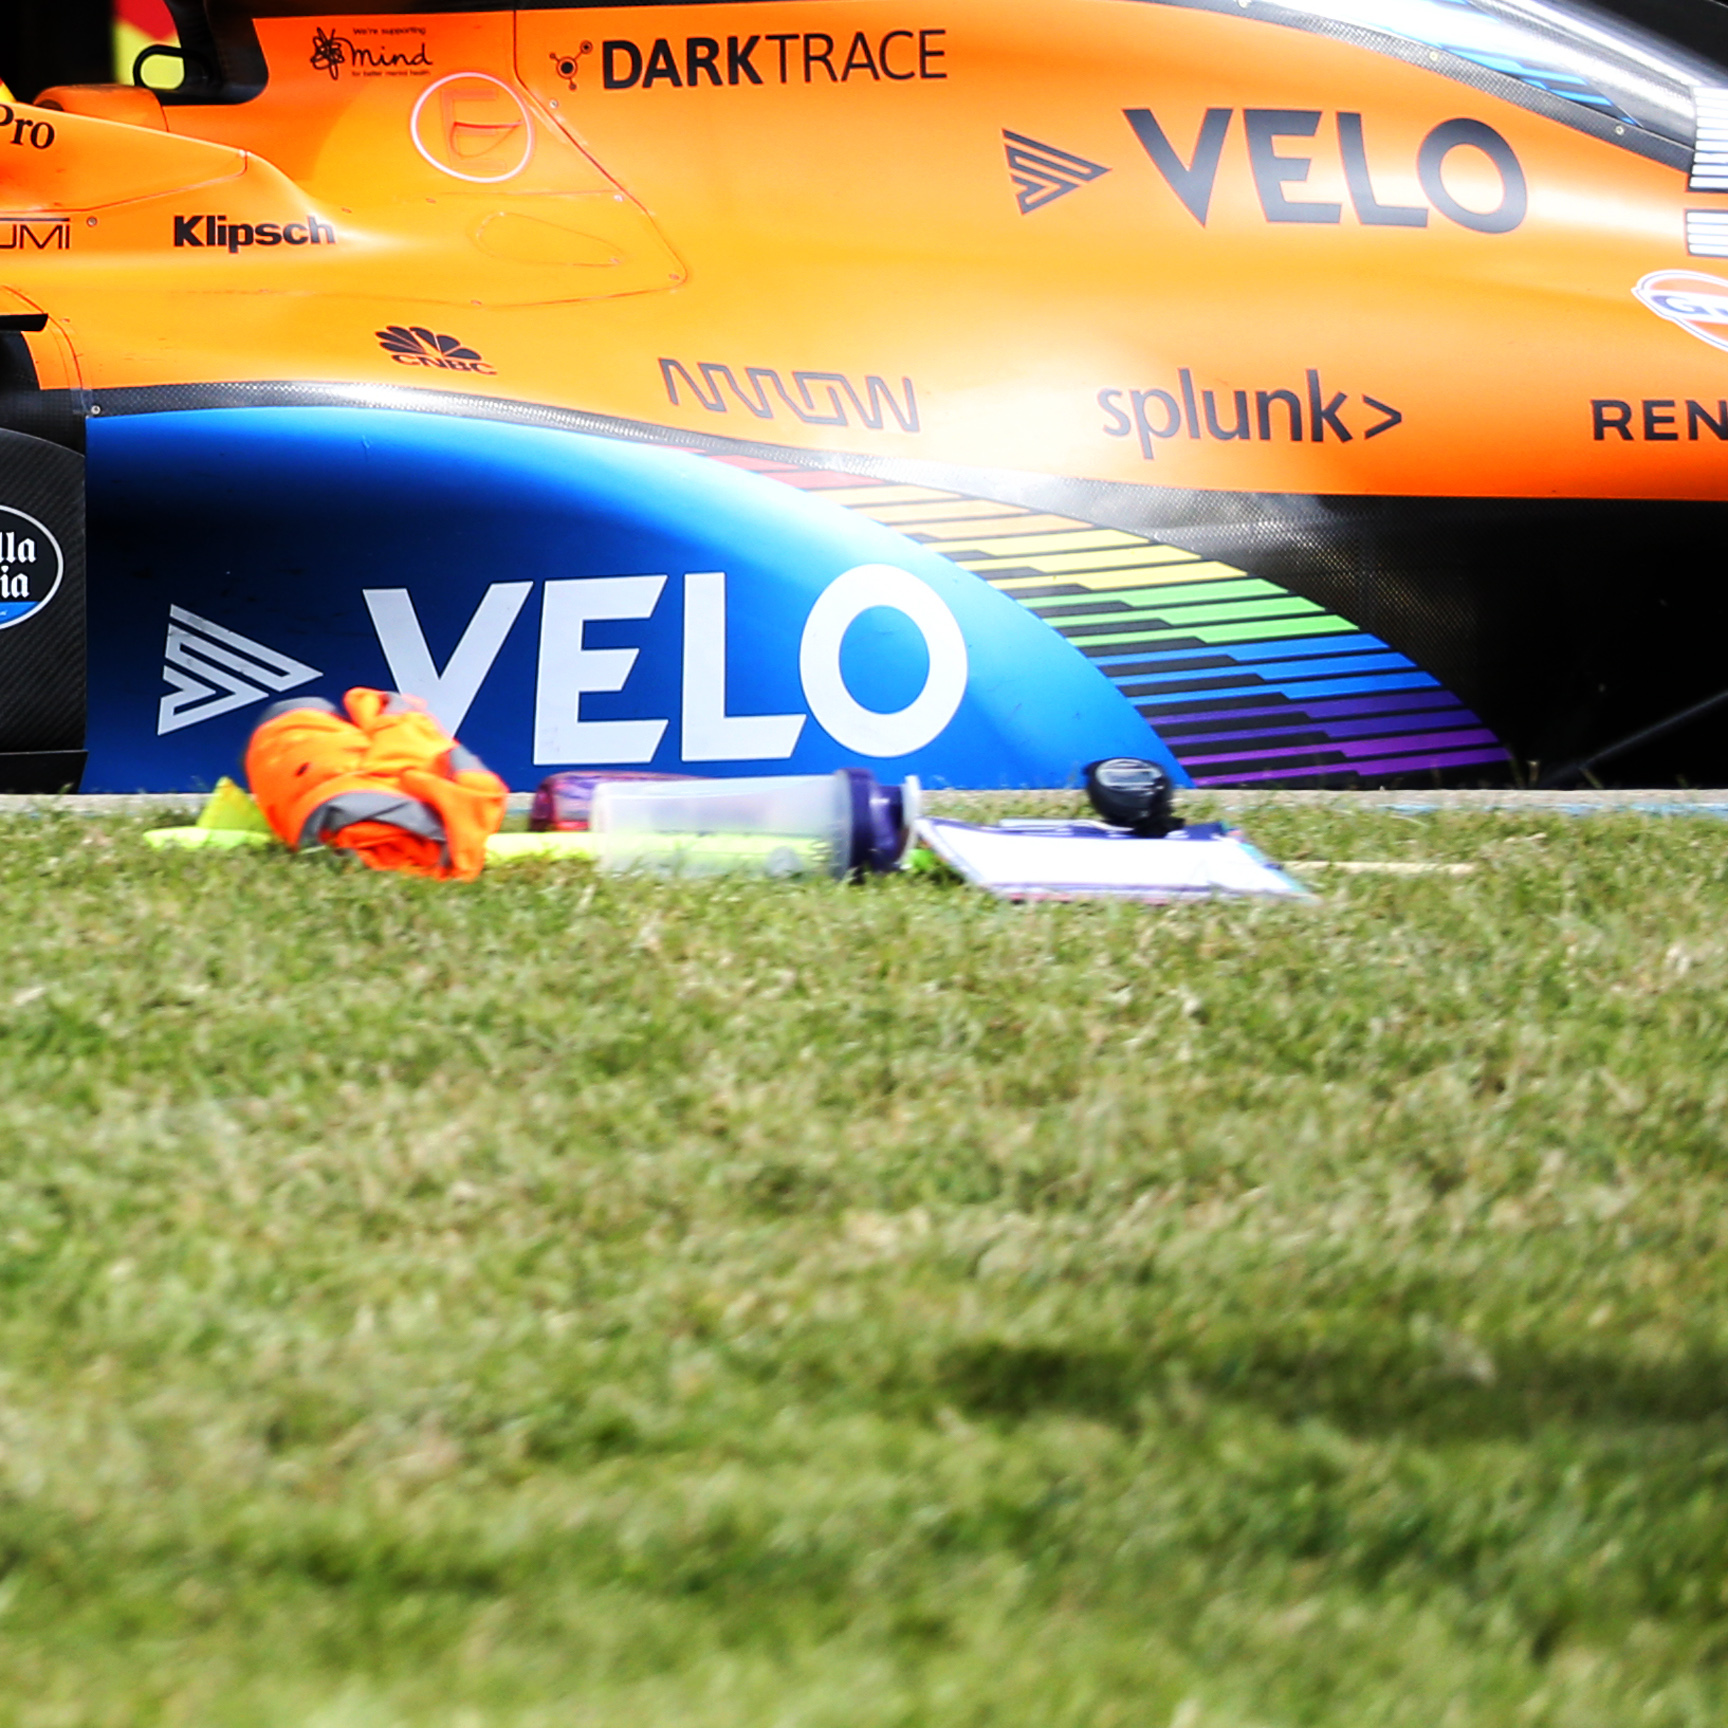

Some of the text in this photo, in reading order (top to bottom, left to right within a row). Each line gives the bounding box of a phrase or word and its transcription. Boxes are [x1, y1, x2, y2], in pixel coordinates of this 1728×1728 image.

[349, 42, 433, 67] mind
[601, 29, 948, 90] DARKTRACE
[1122, 108, 1527, 234] VELO
[173, 214, 336, 254] Klipsch
[391, 354, 497, 375] CNBC
[363, 563, 969, 765] VELO
